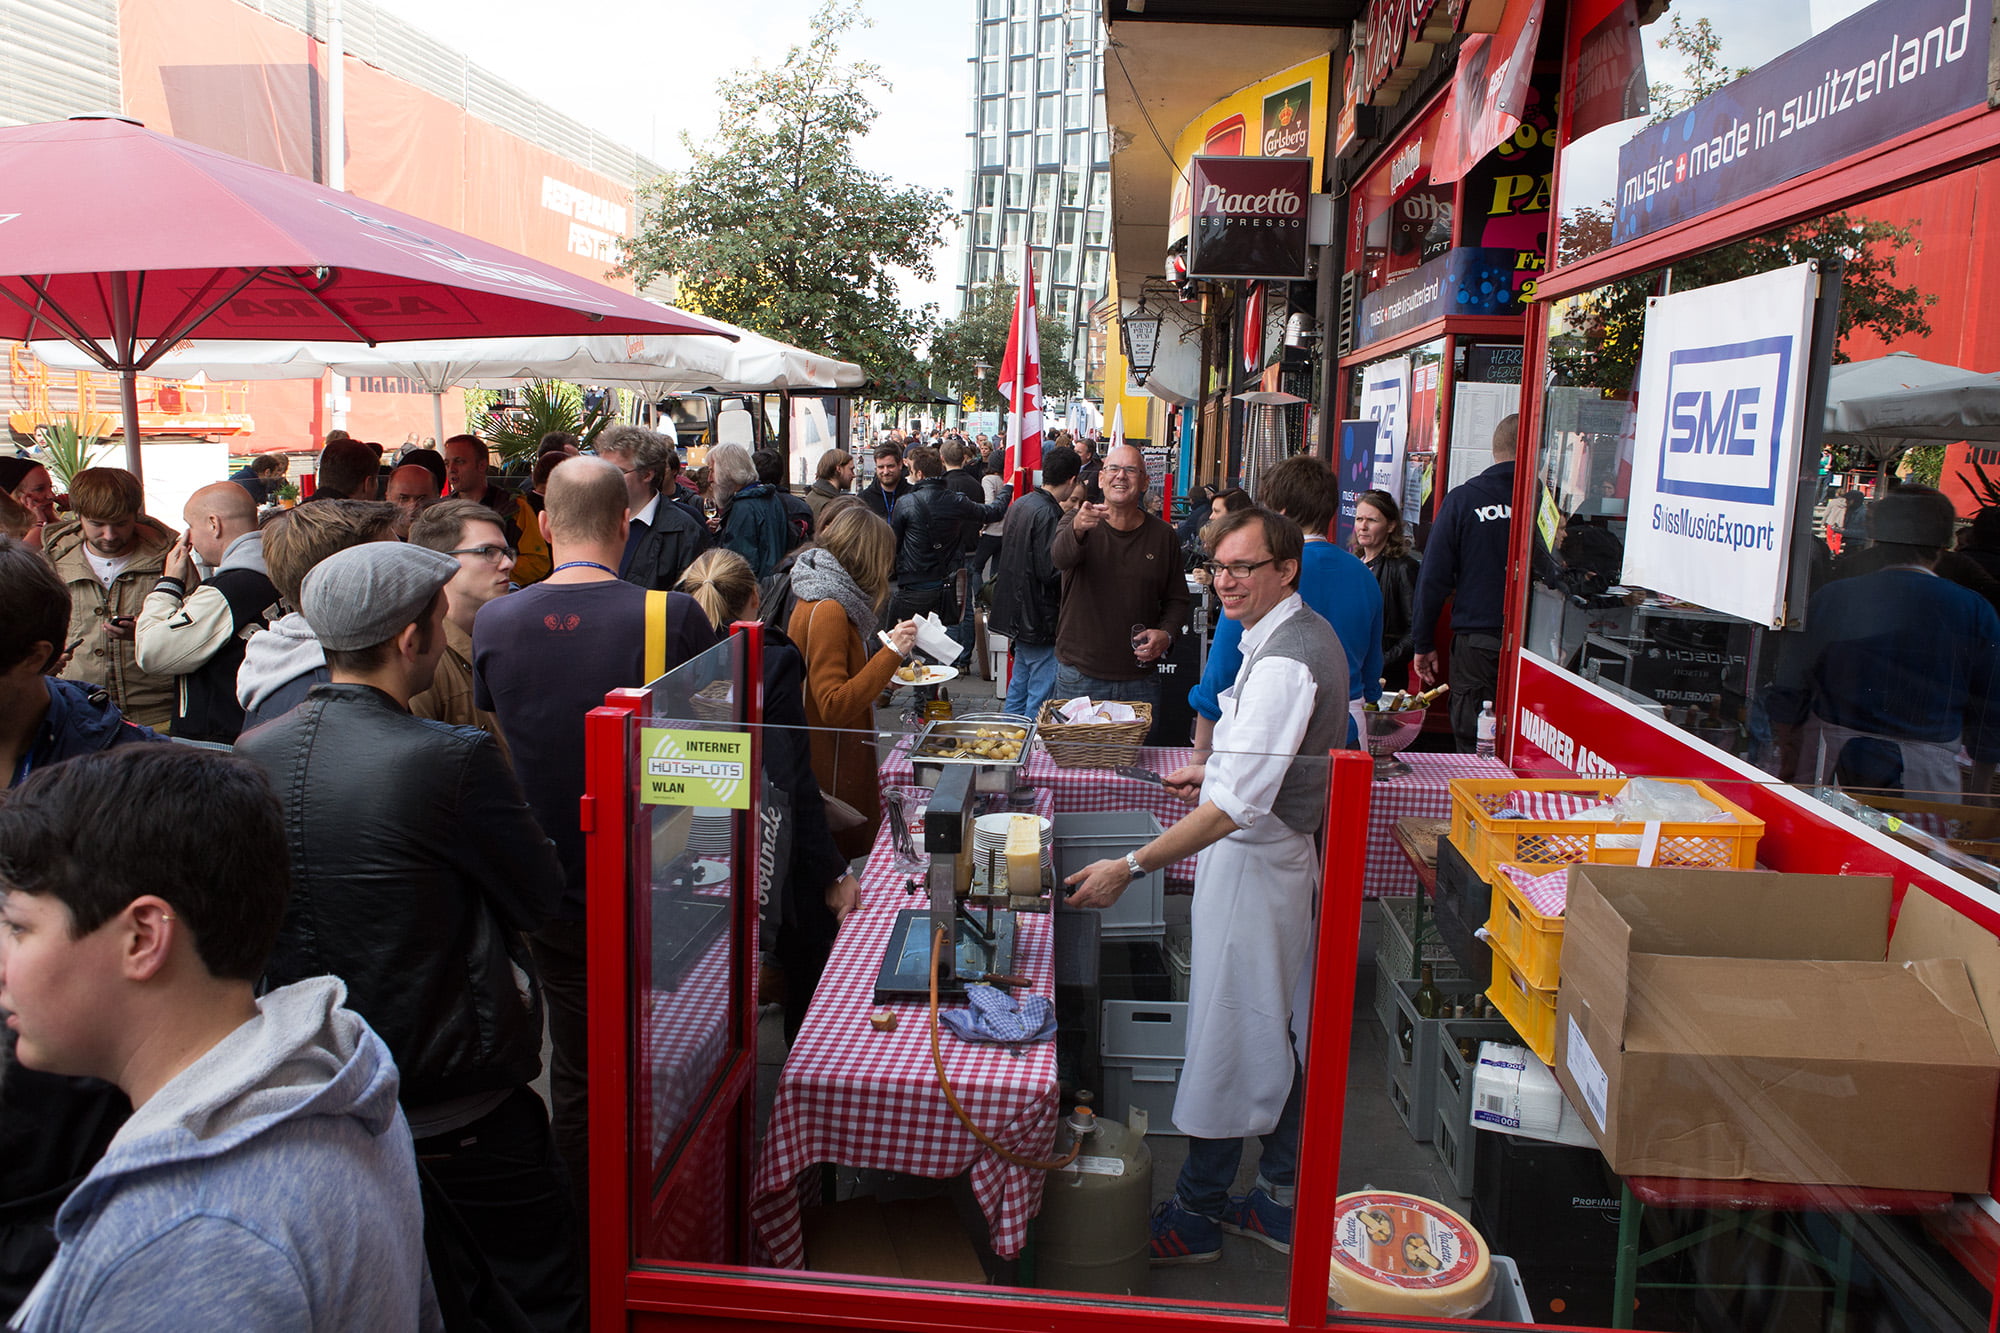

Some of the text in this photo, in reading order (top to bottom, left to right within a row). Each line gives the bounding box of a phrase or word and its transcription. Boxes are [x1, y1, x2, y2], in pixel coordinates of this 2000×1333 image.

[1623, 0, 1972, 208] music made in switzerland
[1264, 126, 1308, 157] Carlsberg
[1200, 184, 1301, 215] Piacetto
[1200, 218, 1300, 228] ESPRESSO
[1669, 386, 1761, 457] SME
[686, 741, 741, 754] INTERNET
[1521, 706, 1627, 779] WAHRER ASTR
[651, 761, 741, 777] HOTSPLOTS
[652, 781, 685, 794] WLAN
[1500, 1117, 1519, 1128] 300
